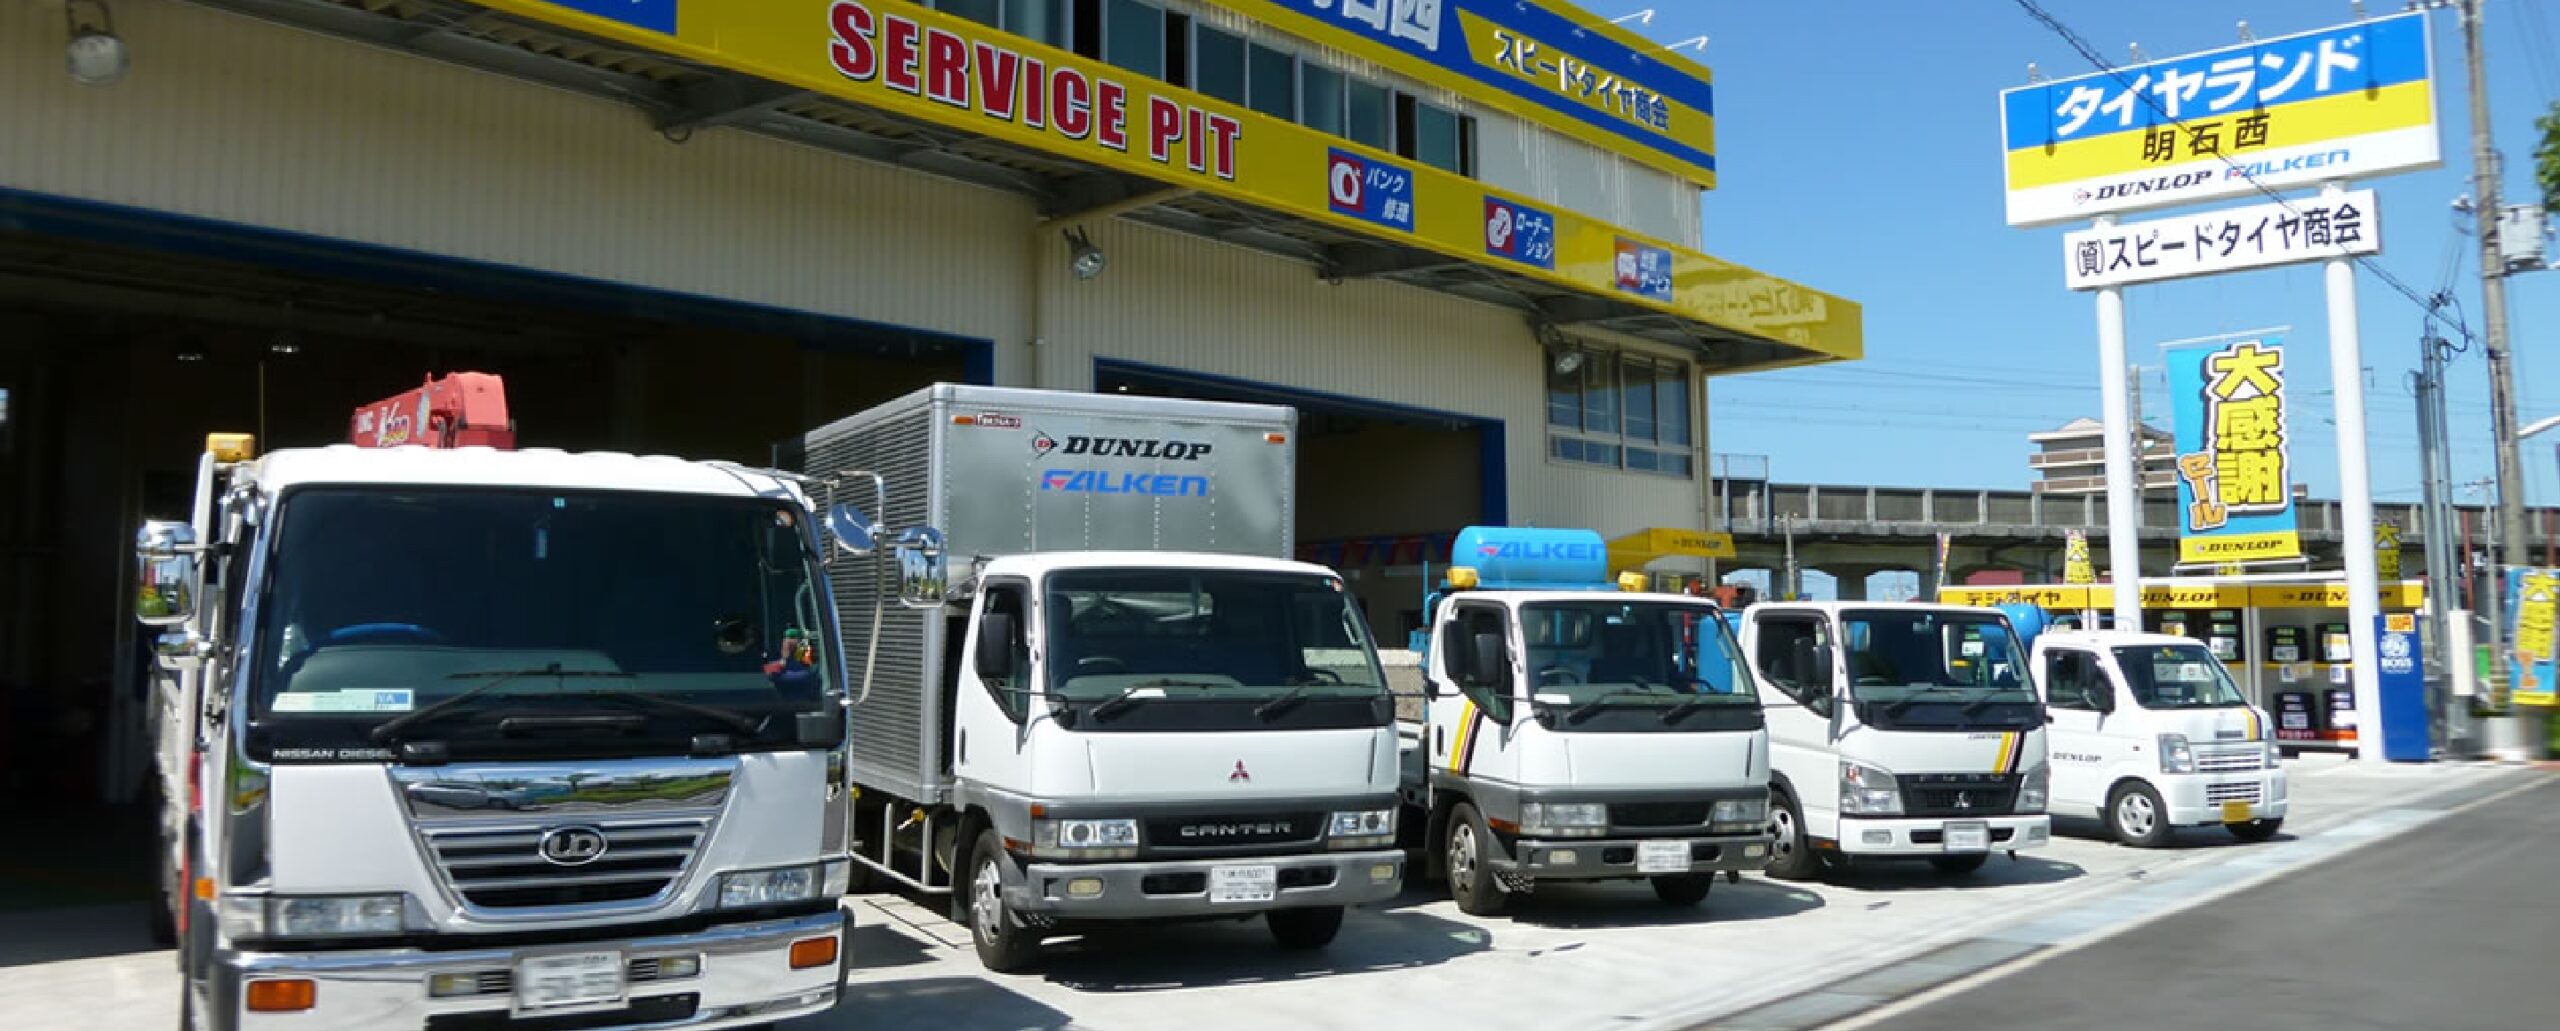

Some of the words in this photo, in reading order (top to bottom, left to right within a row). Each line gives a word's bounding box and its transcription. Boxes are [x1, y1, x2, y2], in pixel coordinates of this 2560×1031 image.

[828, 0, 1127, 151] SERVICE
[1149, 95, 1242, 180] PIT
[1494, 29, 1669, 131] スピードタイヤ商会
[2056, 35, 2363, 136] タイヤランド
[2142, 113, 2270, 162] 明石西
[1366, 167, 1405, 192] パンク
[2095, 170, 2213, 201] DUNLOP
[2224, 148, 2350, 181] FALKEN
[1063, 436, 1212, 460] DUNLOP
[2212, 344, 2282, 505] 大感謝
[1041, 469, 1209, 497] FALKEN
[2179, 453, 2225, 529] セール
[2208, 540, 2283, 556] DUNLOP
[273, 749, 334, 759] NISSAN
[338, 748, 397, 759] DIESEL
[1181, 823, 1291, 837] CANTER
